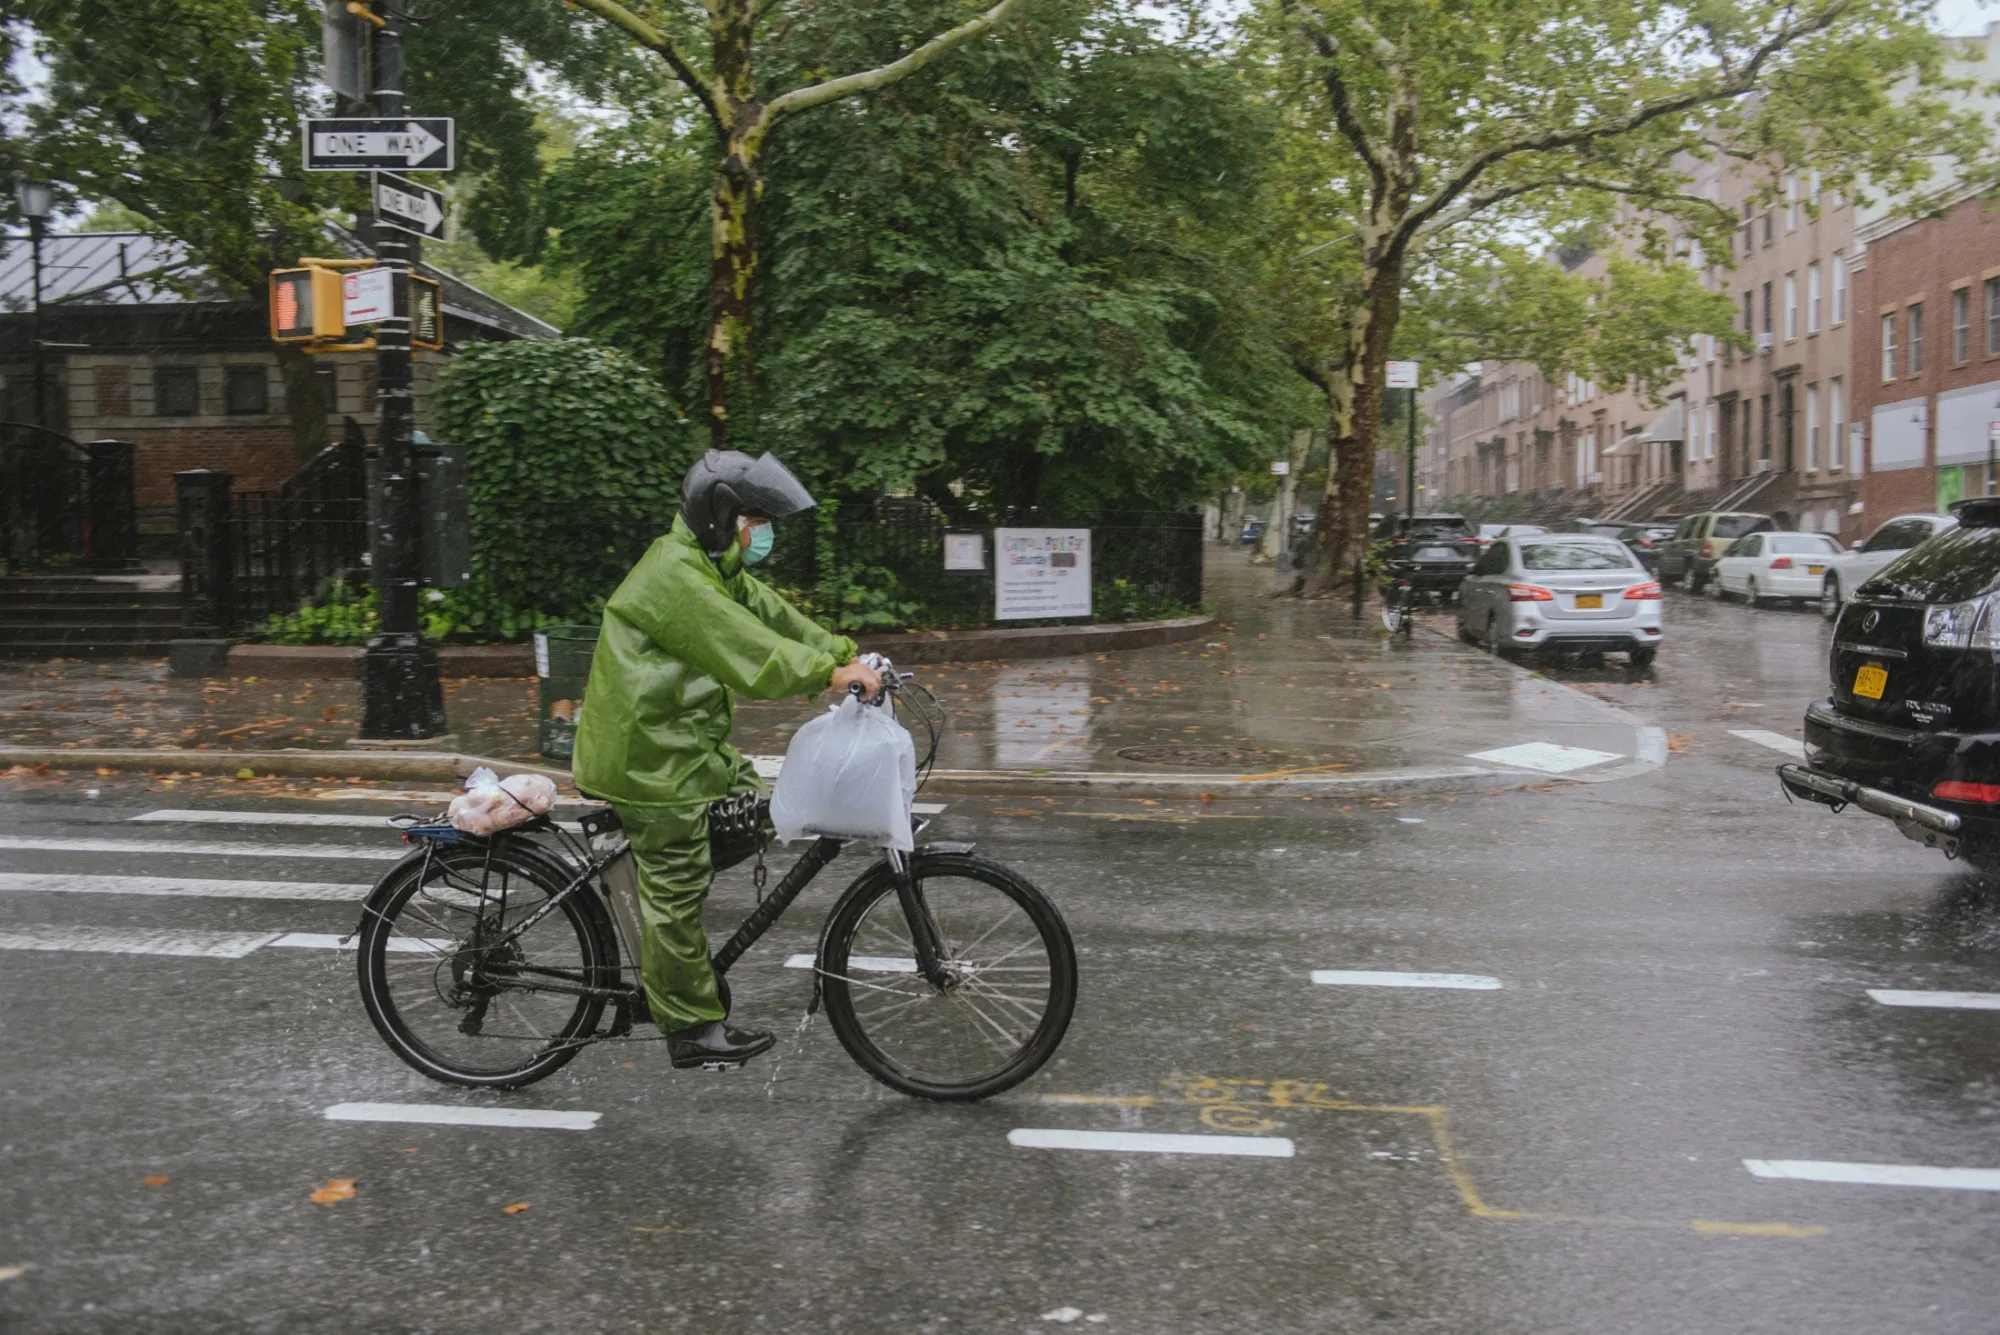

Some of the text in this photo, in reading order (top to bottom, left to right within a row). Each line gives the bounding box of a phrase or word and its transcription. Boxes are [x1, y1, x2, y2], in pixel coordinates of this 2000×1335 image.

[325, 134, 429, 154] ONE WAY
[381, 188, 428, 220] ONE WAY
